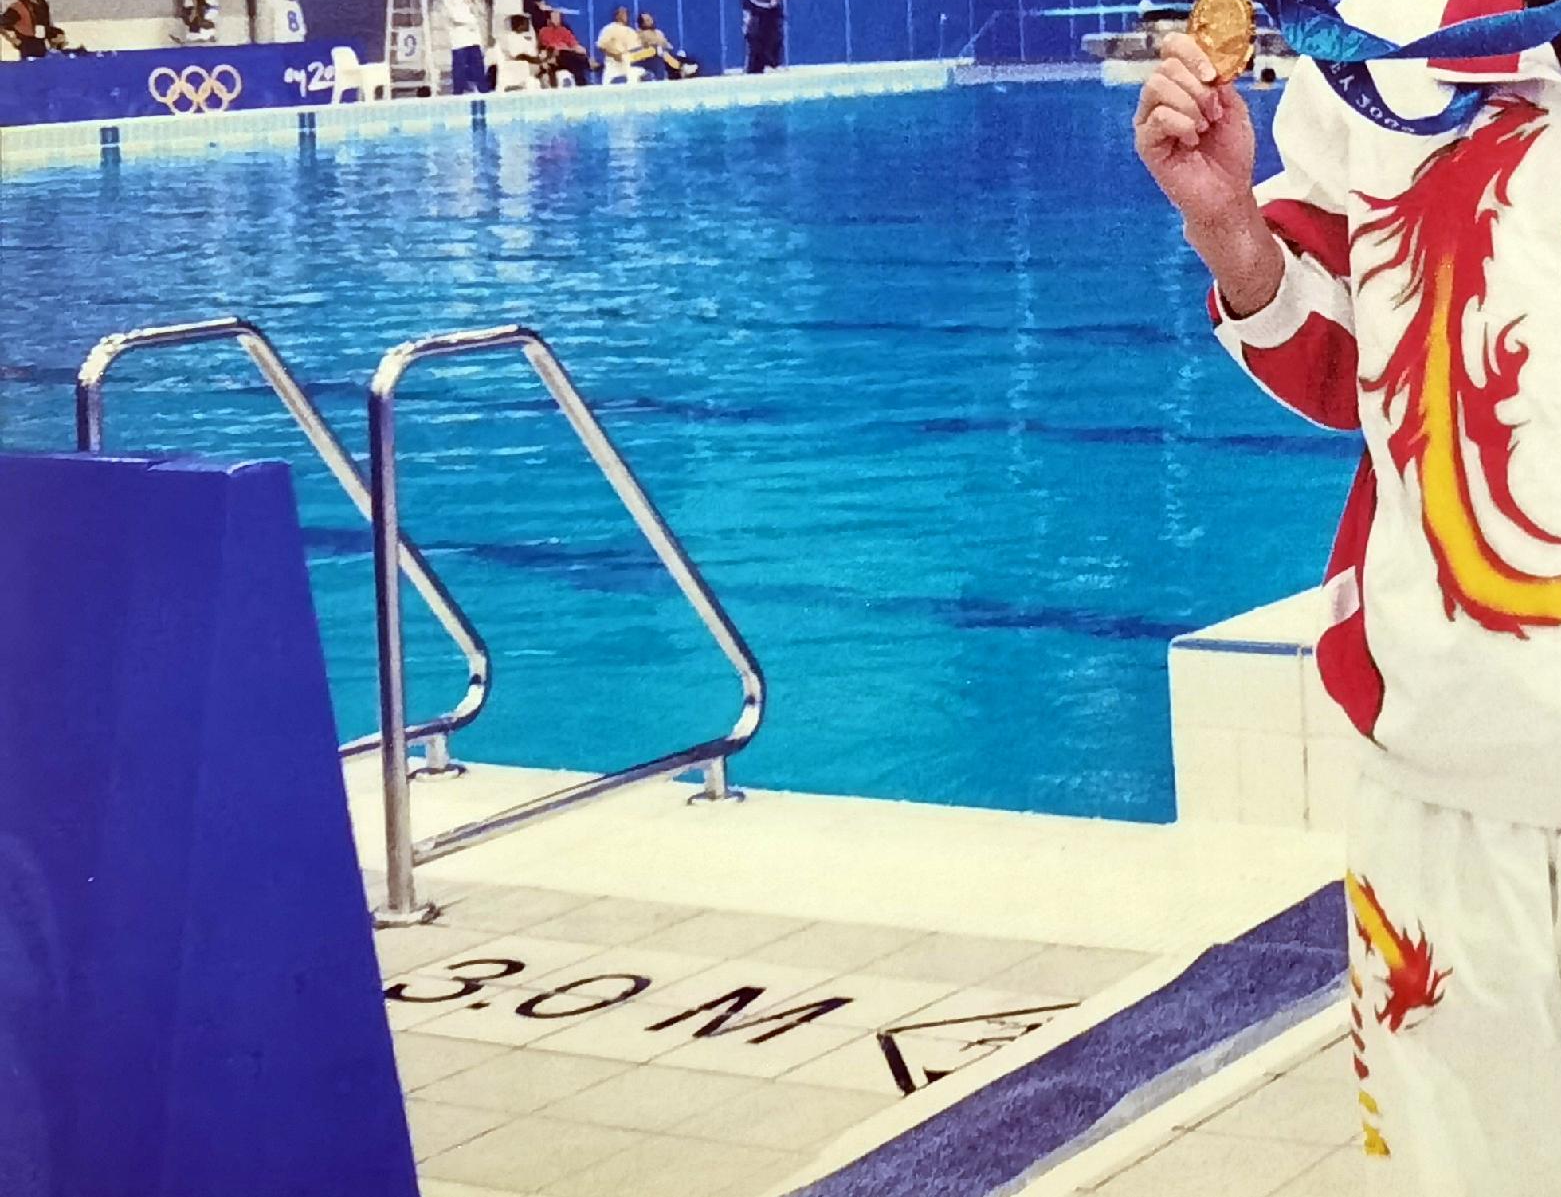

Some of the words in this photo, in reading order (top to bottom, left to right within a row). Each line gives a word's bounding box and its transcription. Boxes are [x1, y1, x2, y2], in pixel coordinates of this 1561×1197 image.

[287, 10, 300, 33] 8
[404, 34, 417, 57] 9
[307, 61, 335, 92] 20
